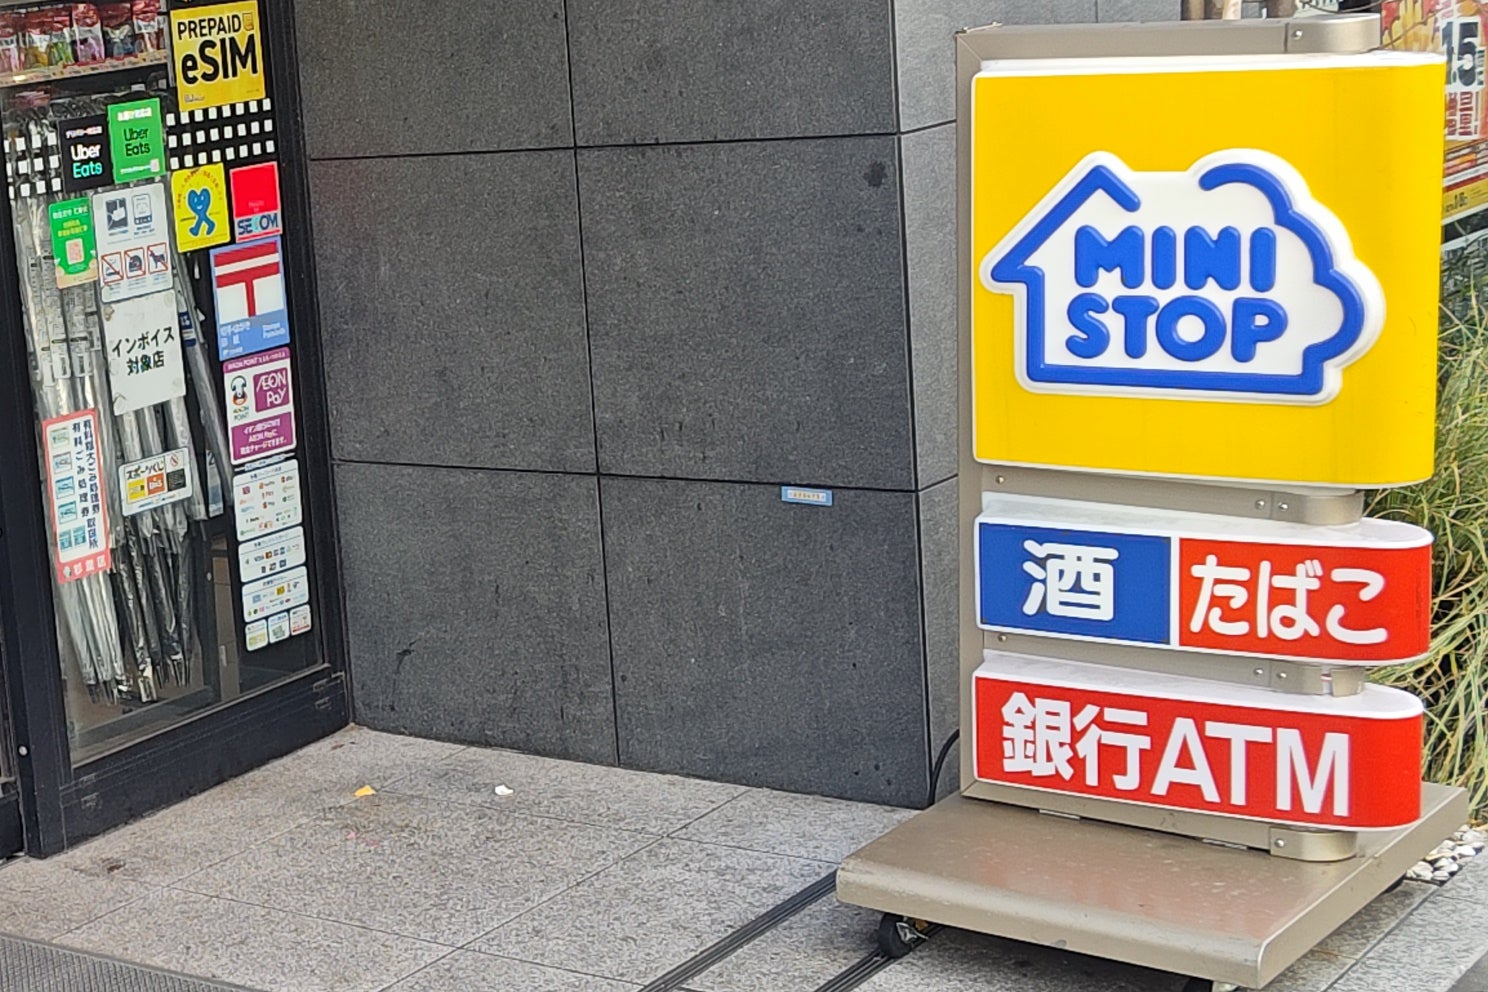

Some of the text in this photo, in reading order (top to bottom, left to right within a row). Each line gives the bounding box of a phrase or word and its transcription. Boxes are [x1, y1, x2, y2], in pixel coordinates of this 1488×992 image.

[177, 14, 242, 40] PREPAID
[181, 33, 258, 85] eSIM
[123, 127, 149, 142] Uber
[71, 144, 101, 160] Uber
[125, 142, 151, 157] Eats
[73, 161, 102, 178] Eats
[237, 213, 279, 236] SECOM
[1074, 224, 1277, 293] MINI
[112, 326, 176, 358] インボイス
[1064, 292, 1288, 363] STOP
[126, 351, 165, 376] 対象店
[1022, 539, 1119, 622] 酒
[1189, 553, 1389, 645] たばこ
[1000, 691, 1350, 819] 銀行ATM
